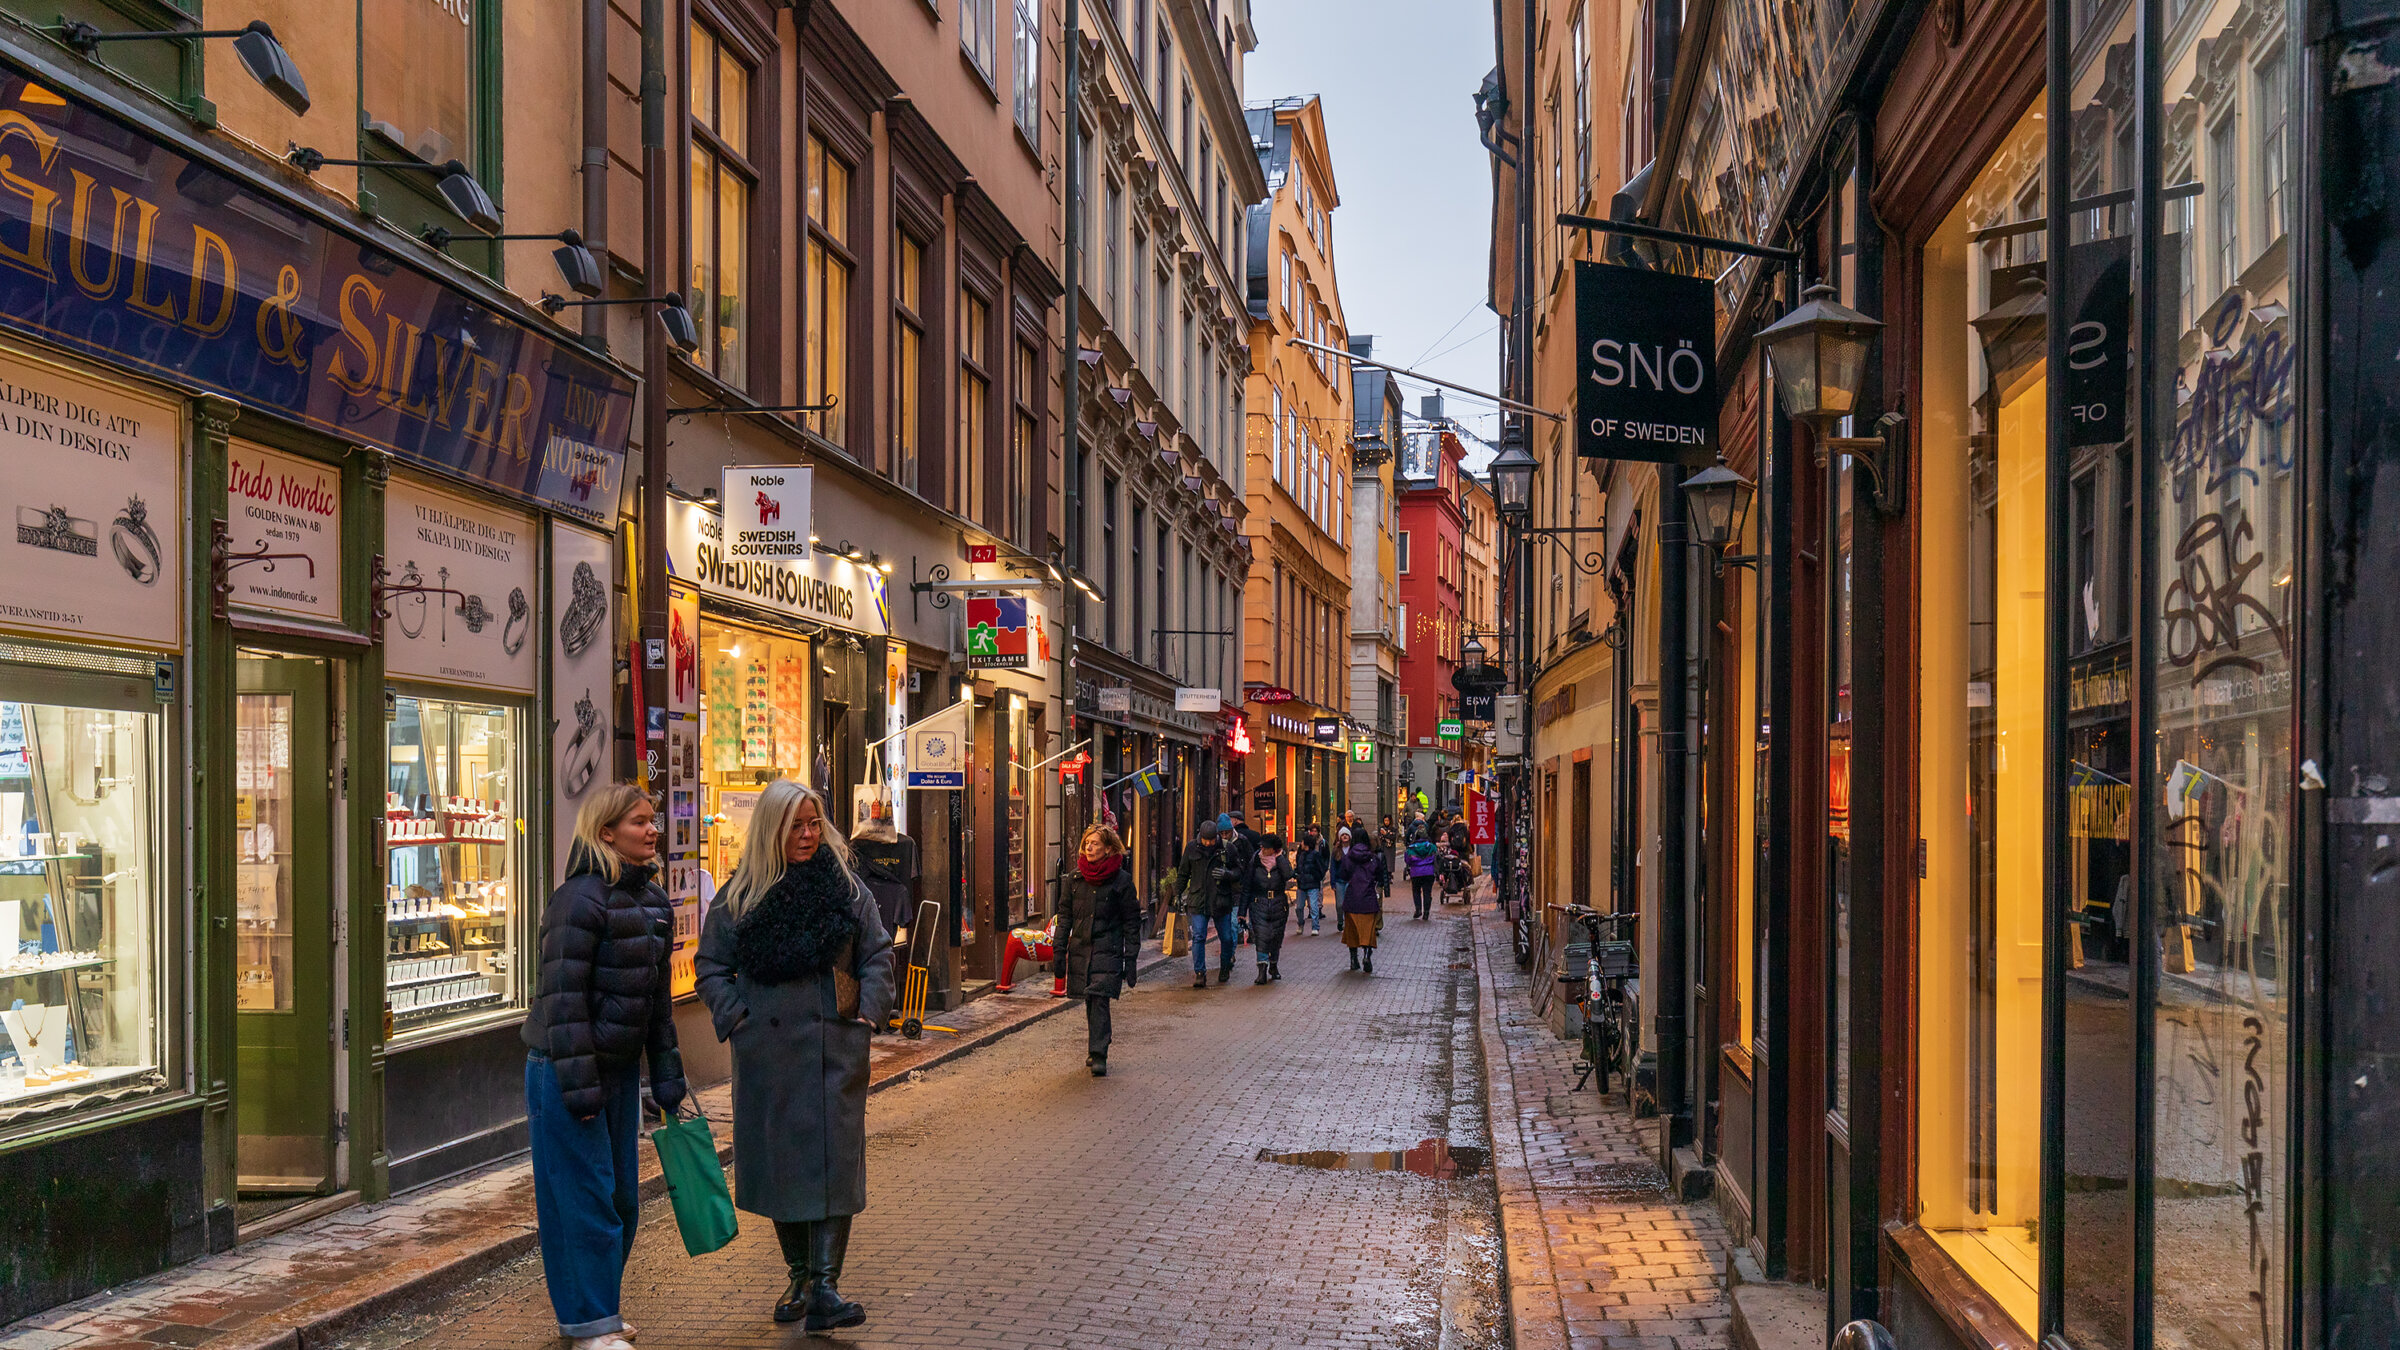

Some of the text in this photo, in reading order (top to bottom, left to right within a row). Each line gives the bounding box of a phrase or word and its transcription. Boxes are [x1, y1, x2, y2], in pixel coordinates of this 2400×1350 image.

[257, 265, 308, 374] &
[1591, 338, 1704, 394] SNÖ
[65, 402, 101, 426] DIG
[106, 417, 140, 438] ATT
[1591, 418, 1705, 445] OF SWEDEN
[16, 415, 54, 442] DIN
[60, 429, 131, 462] DESIGN
[229, 459, 336, 517] Indo Nordic
[750, 475, 785, 487] Noble
[245, 505, 322, 534] (GOLDEN SWAN AB)
[415, 504, 516, 546] VI HJÄLPER DIG ATT
[698, 516, 722, 541] Noble
[265, 528, 300, 543] sedan 1979
[417, 526, 511, 563] SKAPA DIN DESIGN
[739, 531, 796, 543] SWEDISH
[731, 544, 803, 555] SOUVENIRS
[249, 583, 318, 605] www.indonordic.se
[697, 541, 853, 621] SWEDISH SOUVENIRS
[62, 611, 76, 624] 3-5
[77, 614, 84, 625] V
[439, 666, 474, 679] LEVERANSTID
[1358, 745, 1369, 760] 7
[1255, 790, 1274, 798] ÖPPET
[1475, 800, 1489, 839] REA
